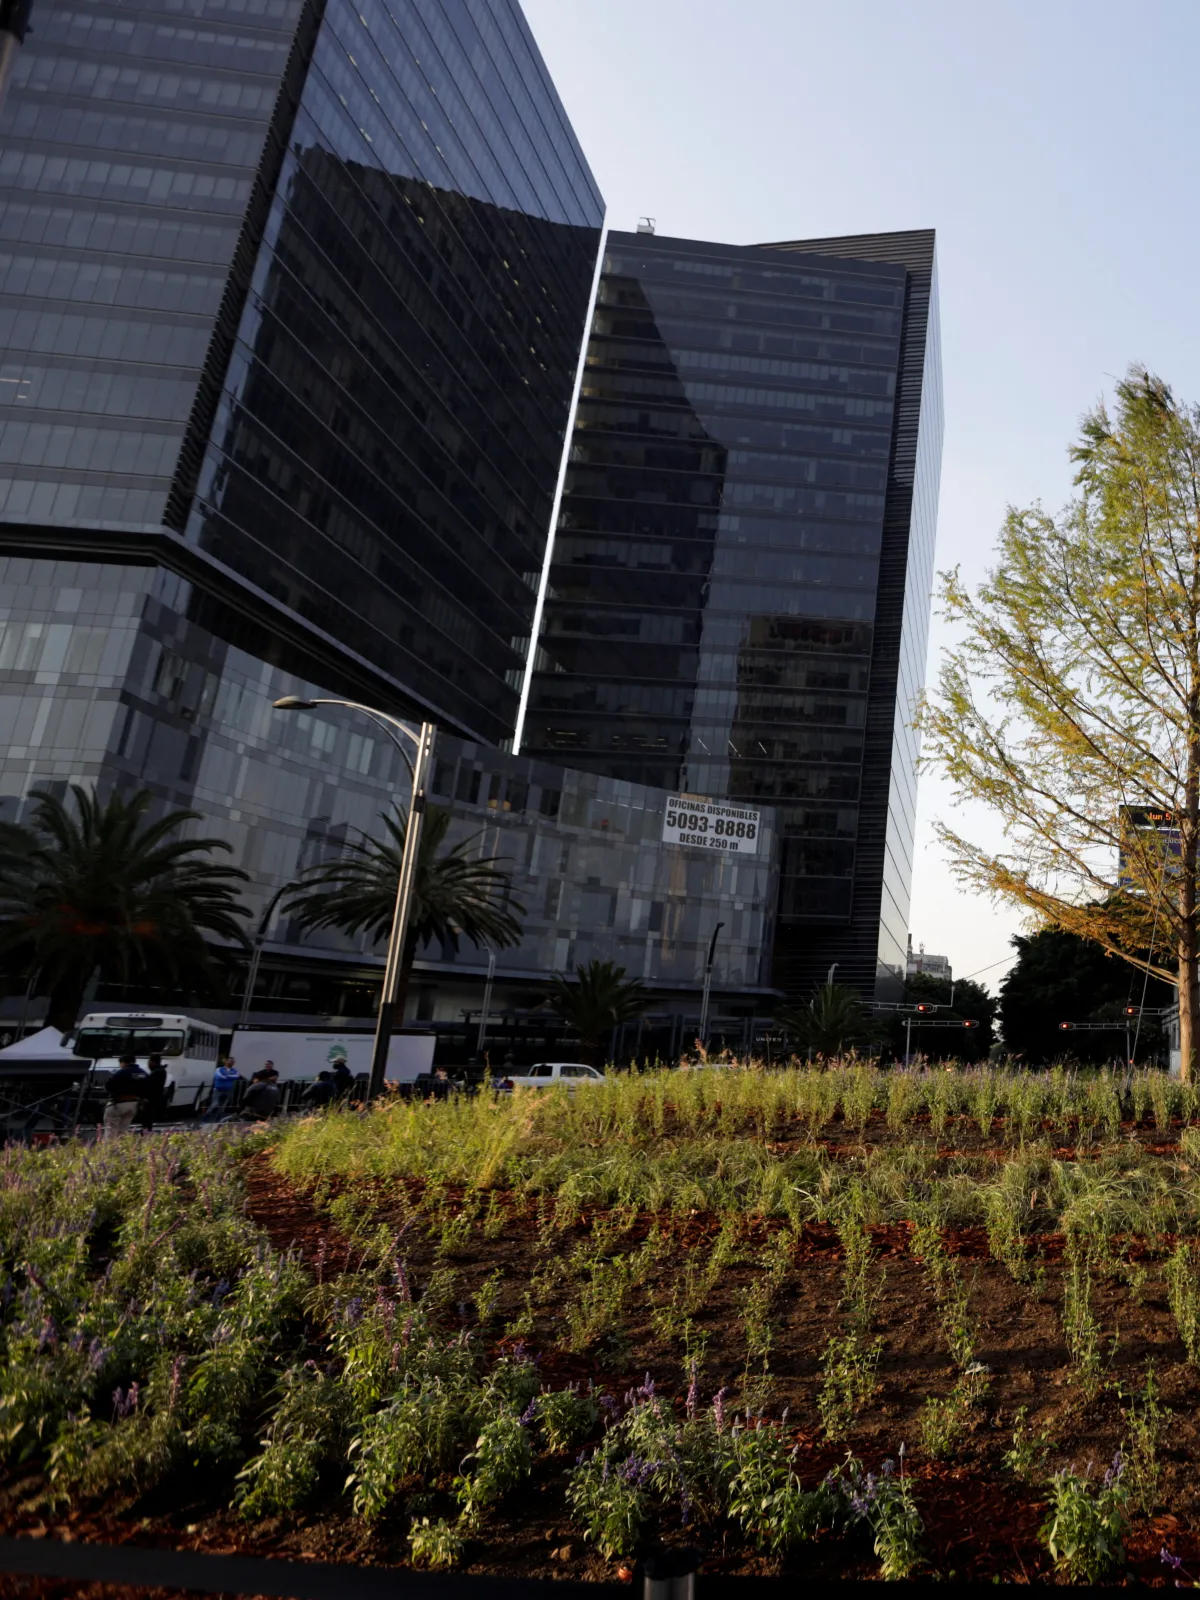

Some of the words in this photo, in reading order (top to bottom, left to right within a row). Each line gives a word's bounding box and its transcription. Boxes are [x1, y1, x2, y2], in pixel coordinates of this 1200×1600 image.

[669, 798, 705, 813] OFICINAS
[707, 805, 758, 821] DISPONIBLES
[1148, 812, 1163, 820] Jun
[667, 811, 756, 839] 5093-8888
[679, 833, 708, 847] DESDE
[708, 837, 728, 849] 250
